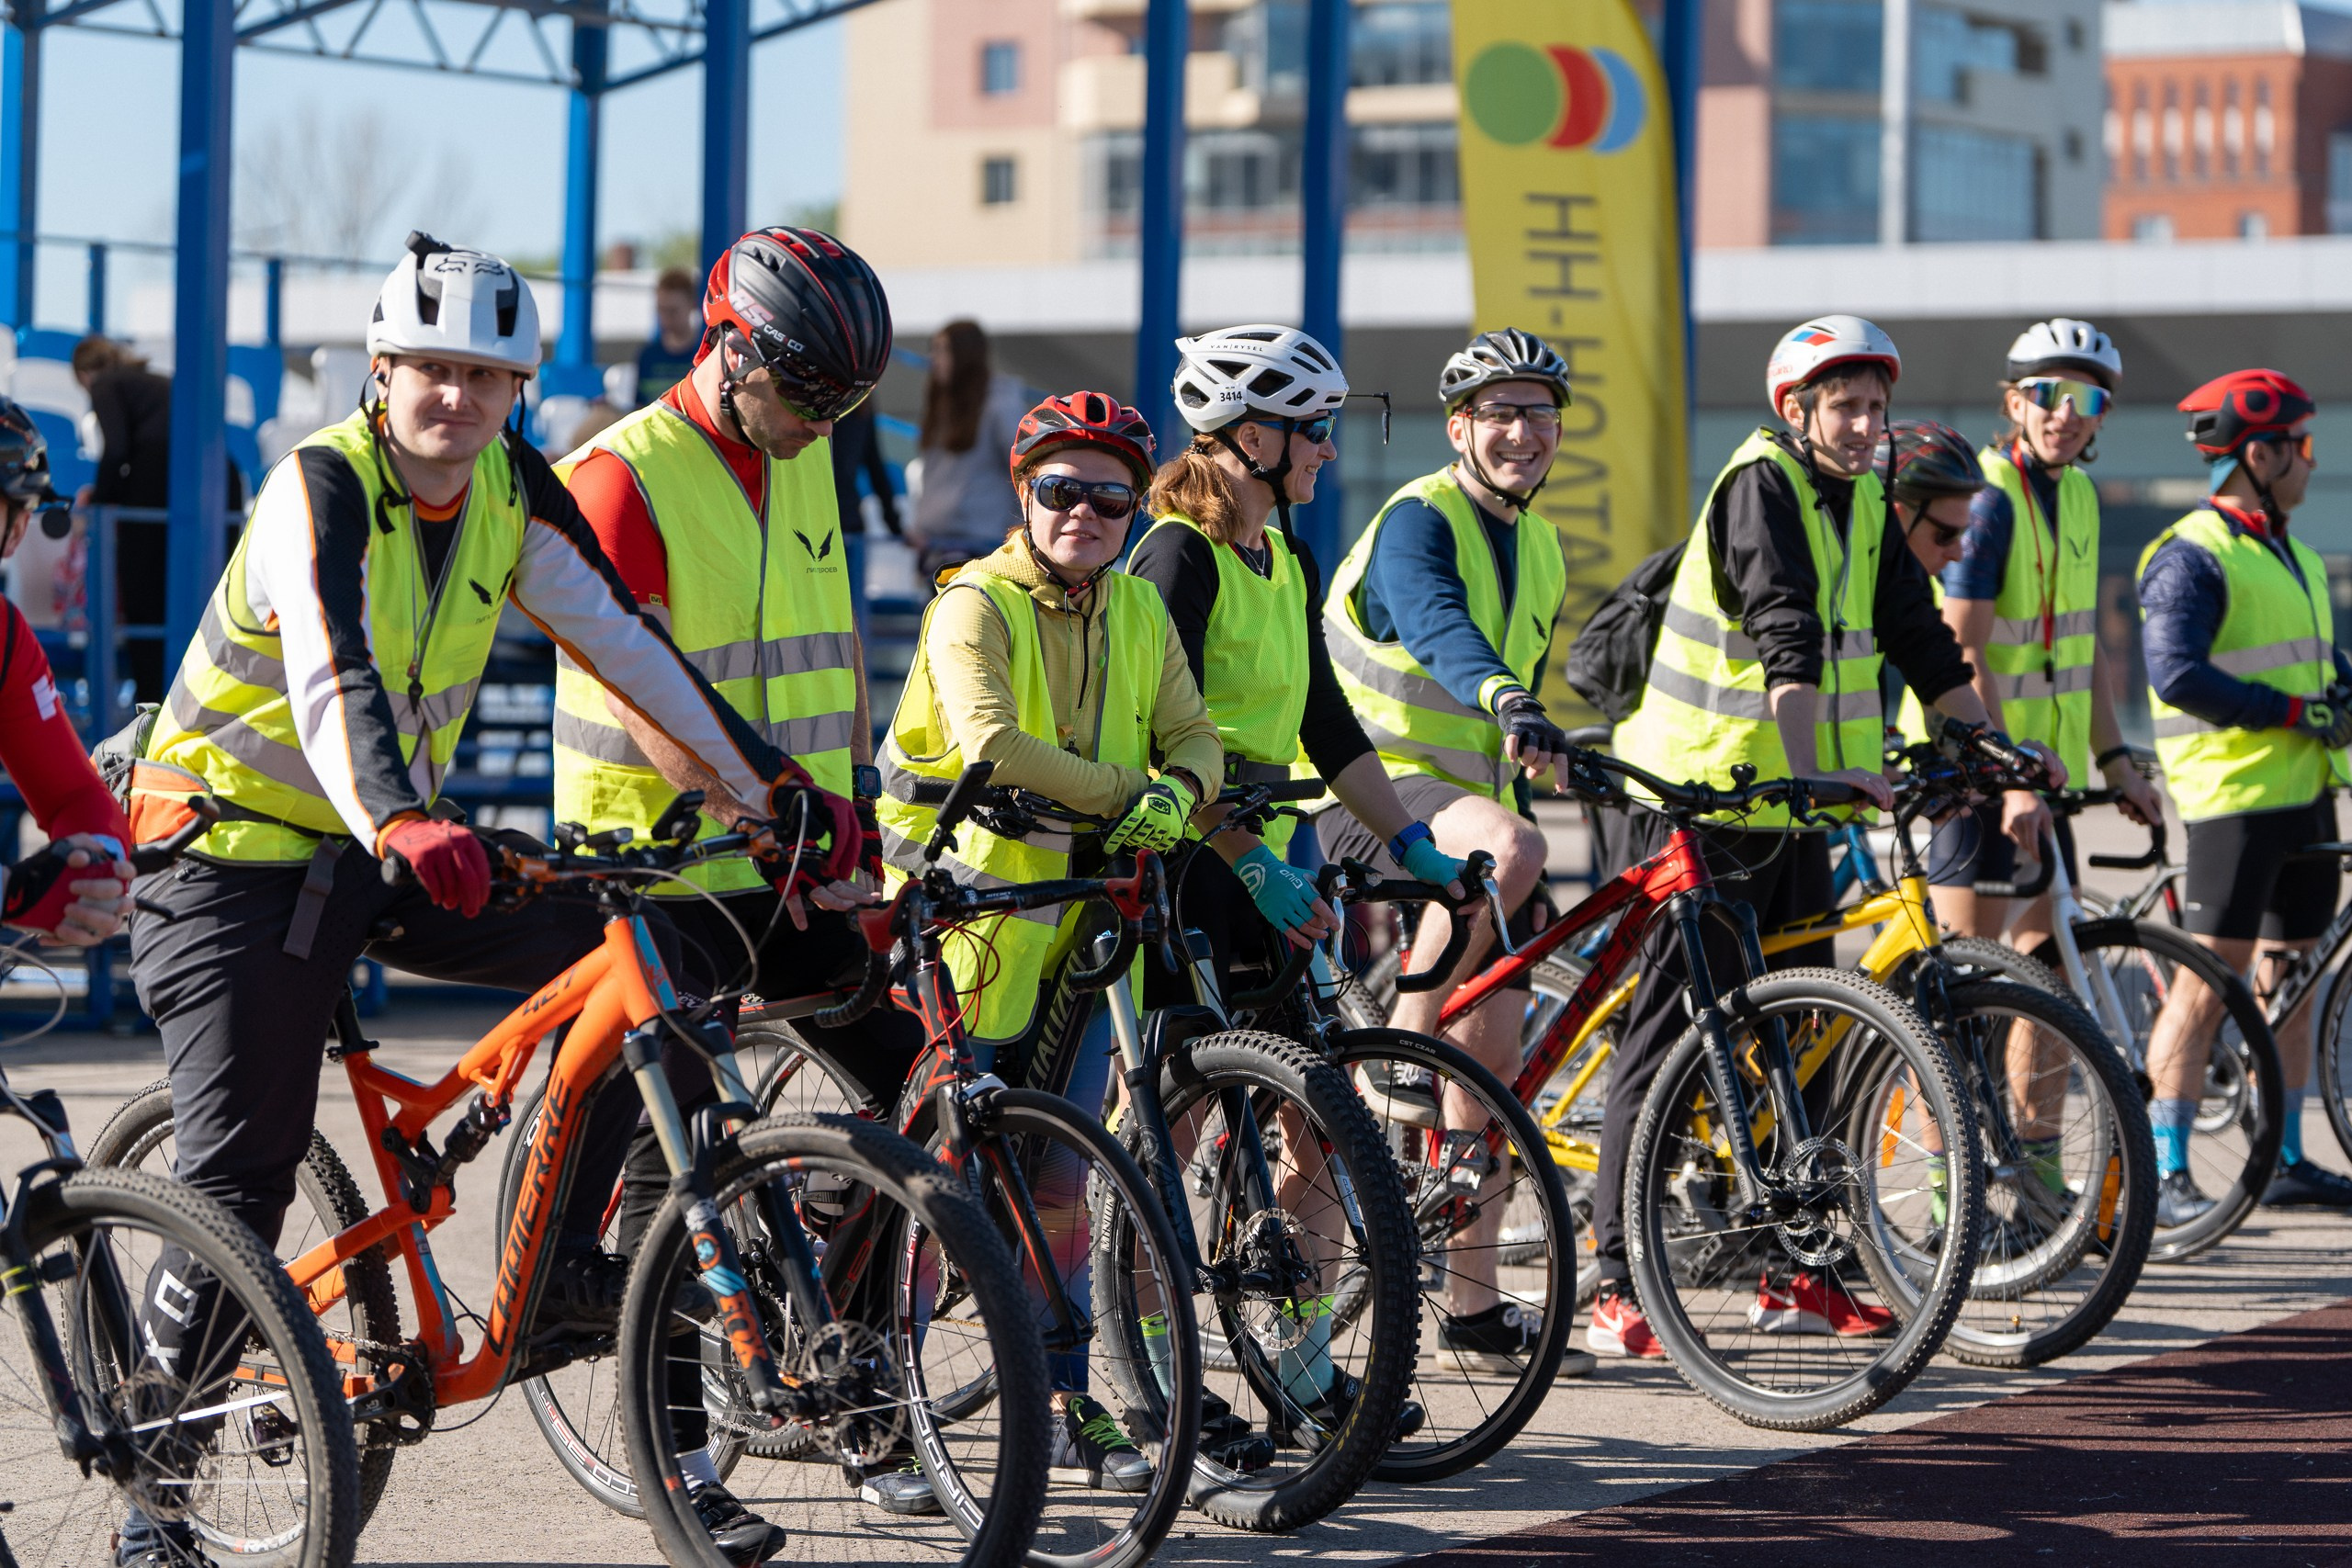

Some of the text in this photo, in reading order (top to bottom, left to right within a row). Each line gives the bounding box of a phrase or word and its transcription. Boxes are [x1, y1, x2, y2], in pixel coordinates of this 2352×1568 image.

[1220, 390, 1242, 402] 3414
[1415, 1043, 1436, 1055] CZAR
[1632, 1108, 1658, 1243] BONTRAGER
[1736, 1168, 1749, 1201] MACHETE
[485, 1066, 571, 1358] LAPIERRE
[1101, 1191, 1116, 1253] MINION
[719, 1291, 768, 1369] FOX
